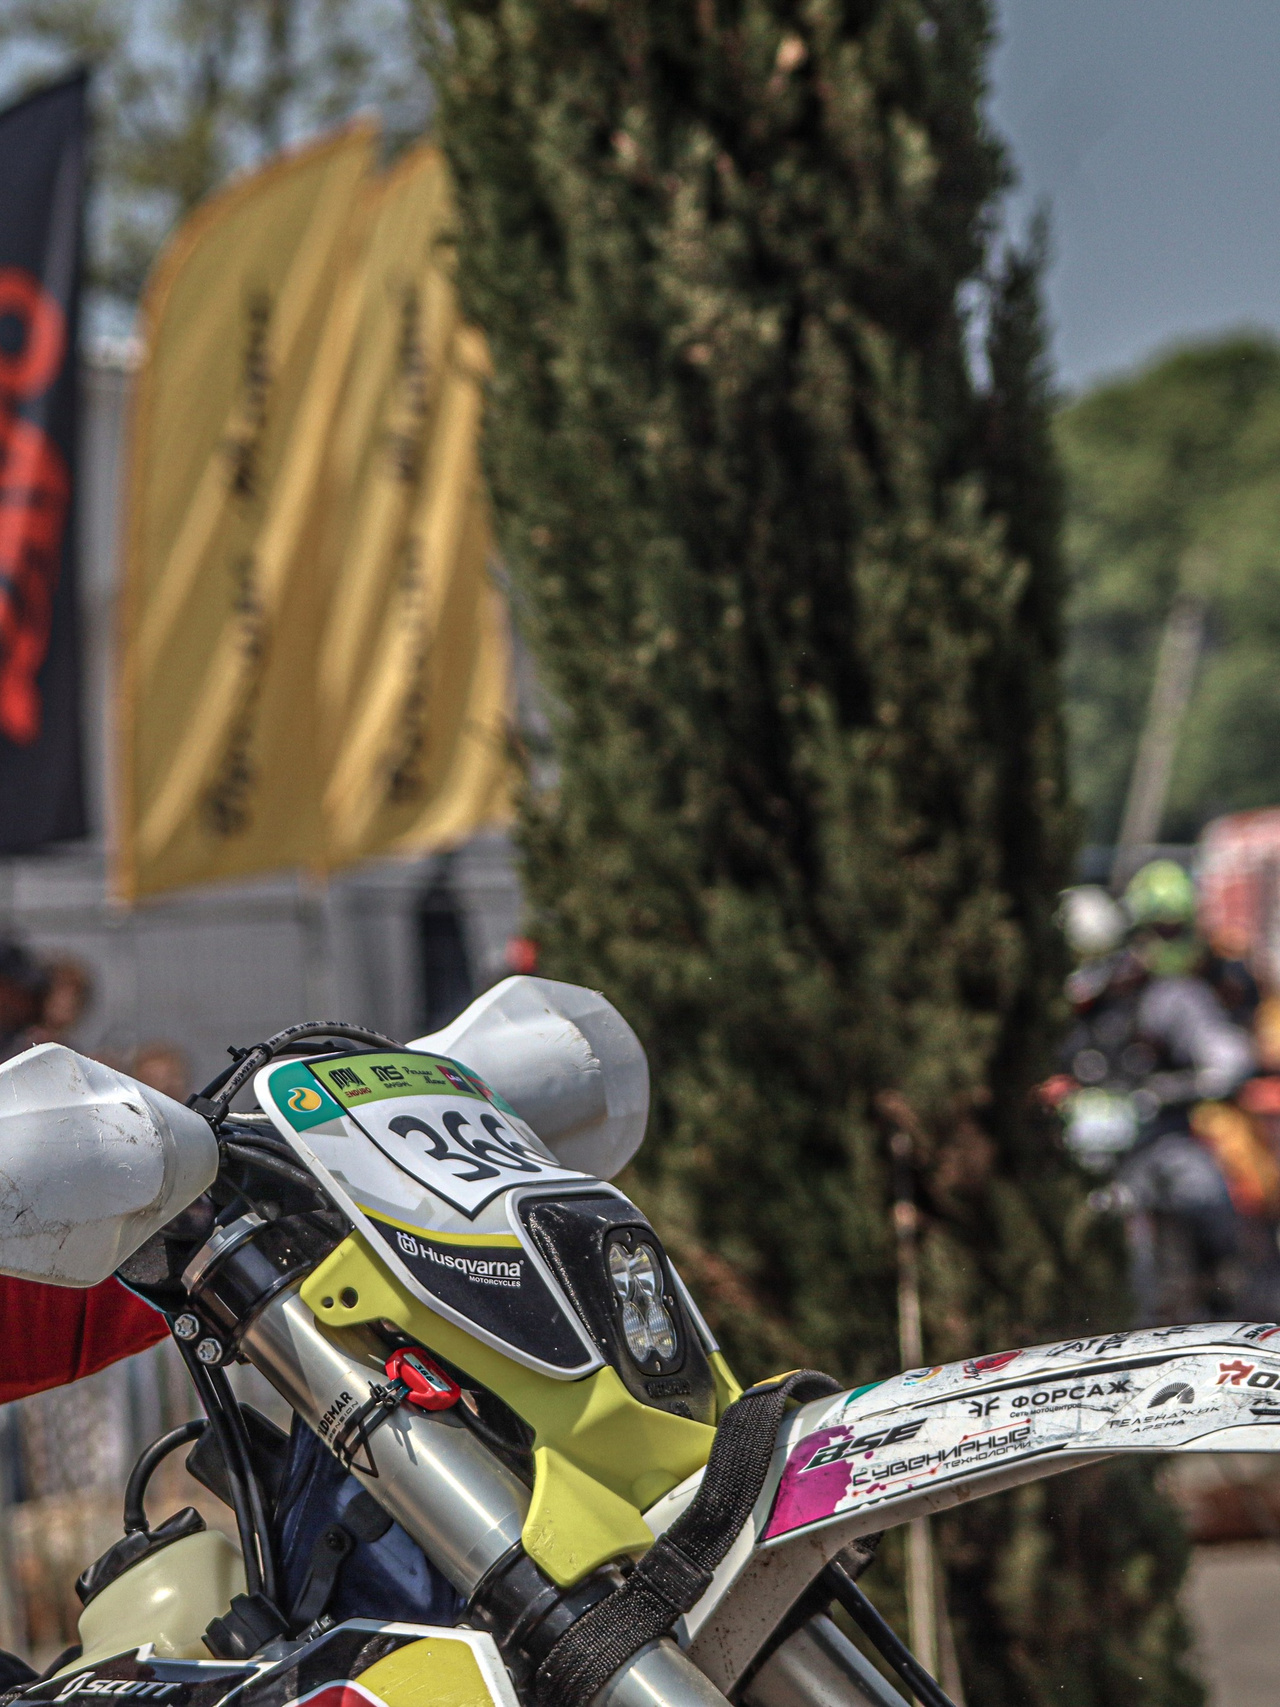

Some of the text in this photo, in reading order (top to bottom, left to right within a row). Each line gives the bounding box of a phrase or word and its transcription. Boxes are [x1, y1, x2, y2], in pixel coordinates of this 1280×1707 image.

[388, 1110, 560, 1182] 366
[420, 1244, 521, 1276] Husqvarna
[469, 1275, 521, 1287] MOTORCYCLES
[1011, 1379, 1131, 1408] ФОРСАЖ
[1009, 1410, 1029, 1418] Сеть
[1131, 1419, 1185, 1433] АРЕНА
[799, 1418, 928, 1474] BSE
[853, 1427, 1031, 1486] СУВЕНИРНЫЕ
[944, 1441, 1032, 1469] ТЕХНОЛОГИИ
[78, 1679, 182, 1698] SCOTT
